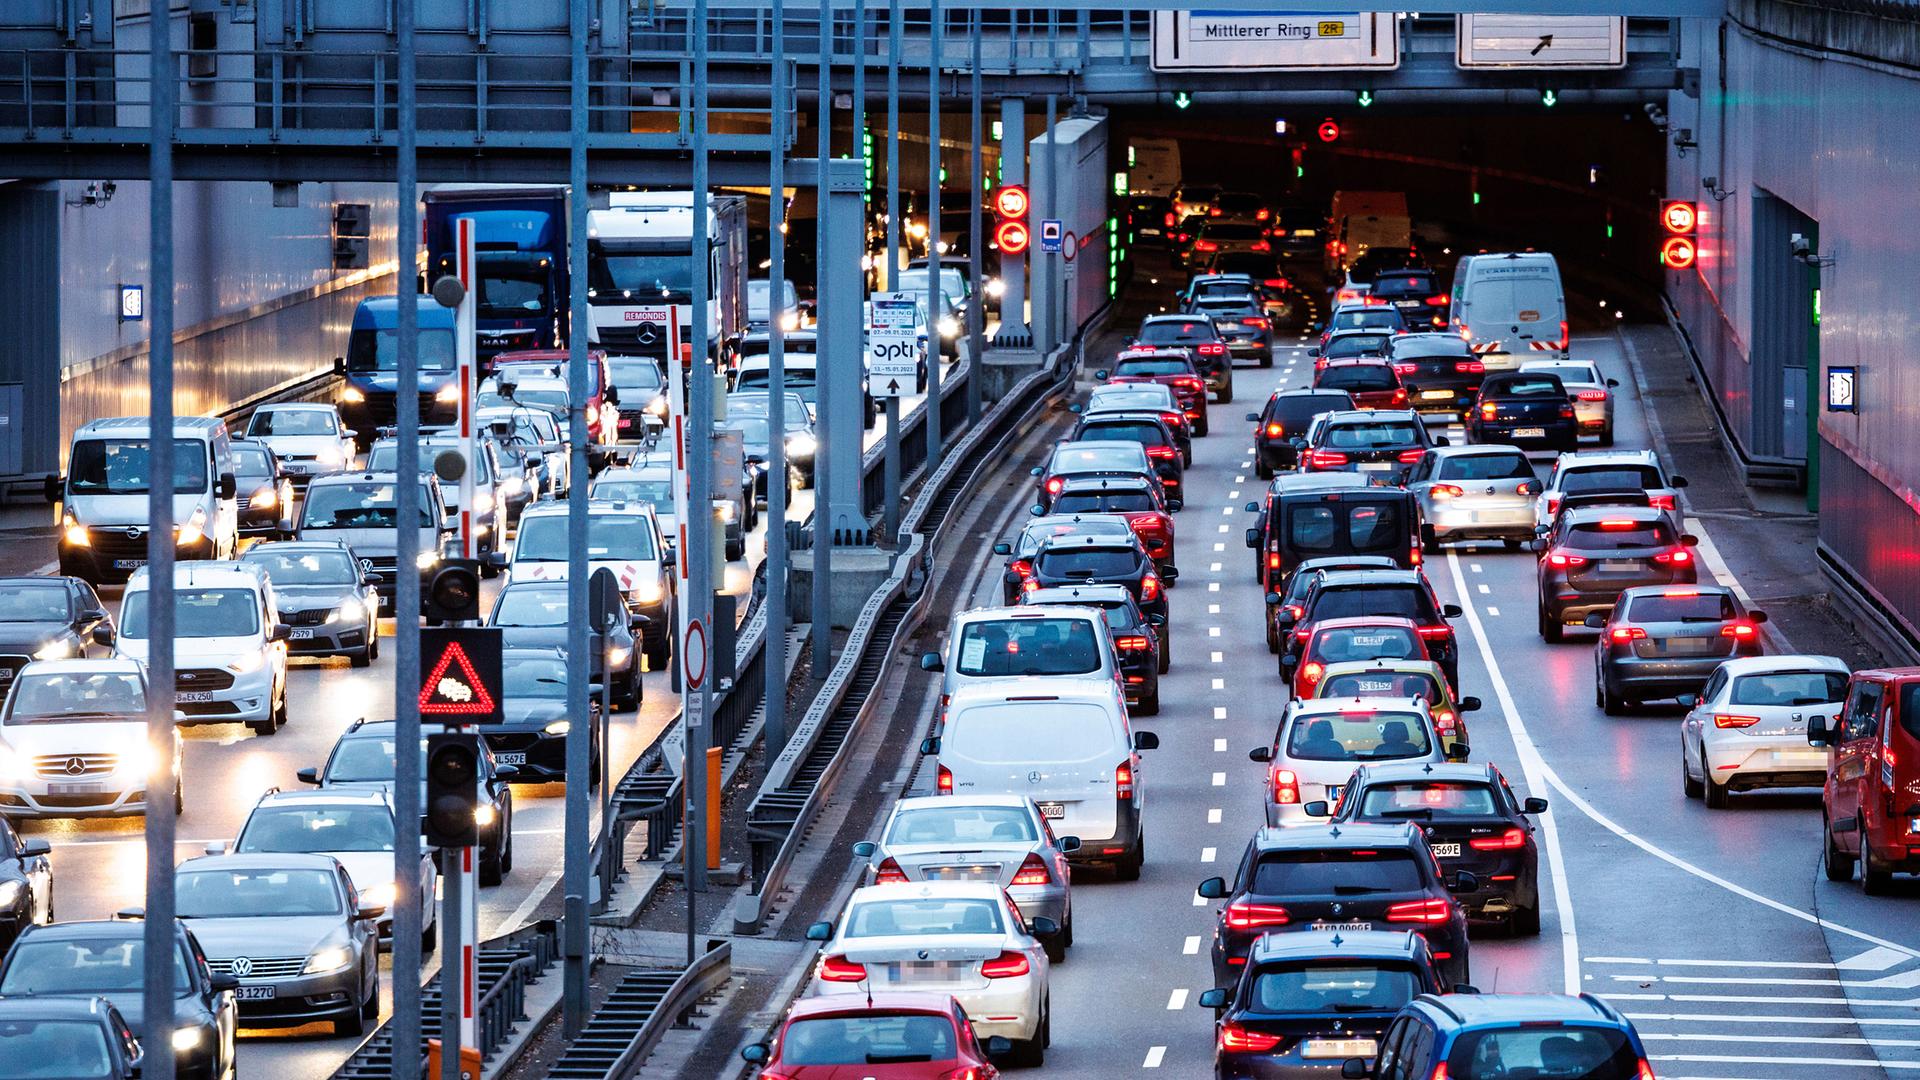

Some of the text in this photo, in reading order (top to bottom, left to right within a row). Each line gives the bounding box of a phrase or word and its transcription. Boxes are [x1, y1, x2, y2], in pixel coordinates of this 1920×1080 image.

[1206, 23, 1311, 39] Mittlerer Ring
[1323, 24, 1338, 34] 2R
[1669, 209, 1691, 226] 50
[625, 311, 666, 320] REMONDIS
[874, 341, 913, 361] opti
[246, 987, 274, 998] 1270
